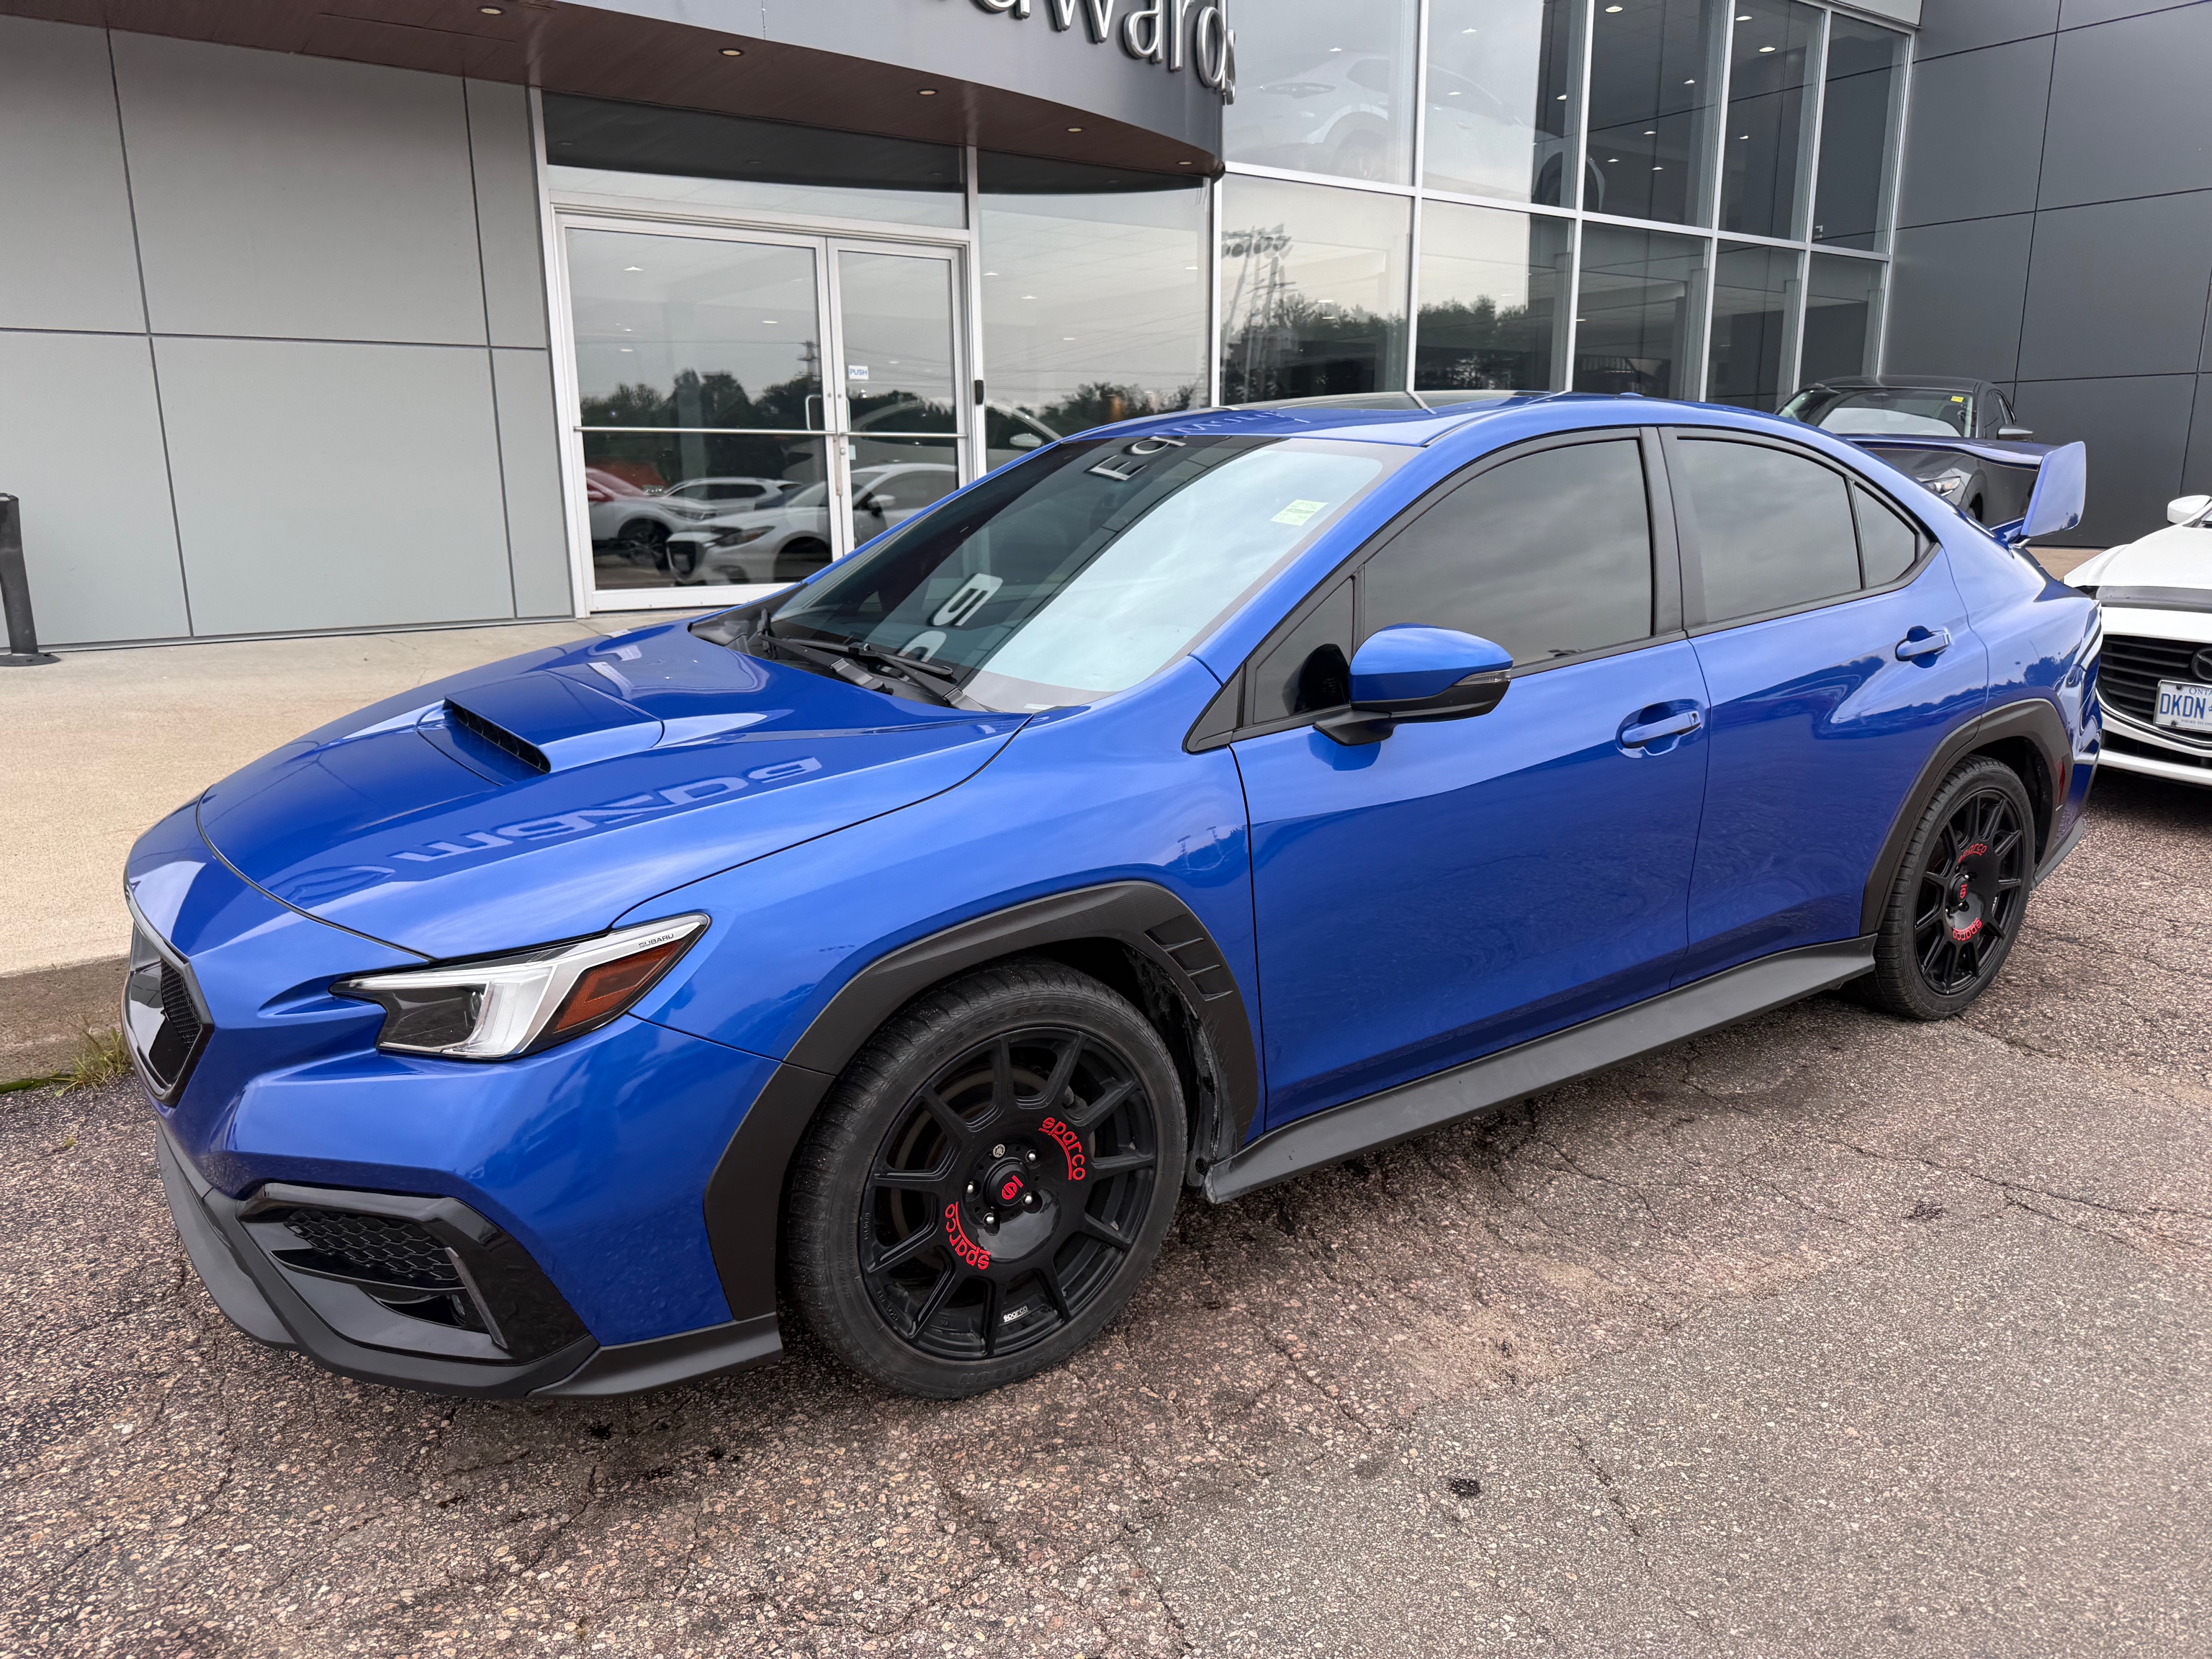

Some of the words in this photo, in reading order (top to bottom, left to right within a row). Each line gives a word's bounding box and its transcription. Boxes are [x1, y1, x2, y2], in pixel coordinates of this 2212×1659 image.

[2159, 693, 2206, 719] DKDN
[638, 933, 674, 948] SUBARU
[1038, 1117, 1087, 1182] sparco
[945, 1201, 992, 1271] sparco
[1003, 1305, 1029, 1323] sparco
